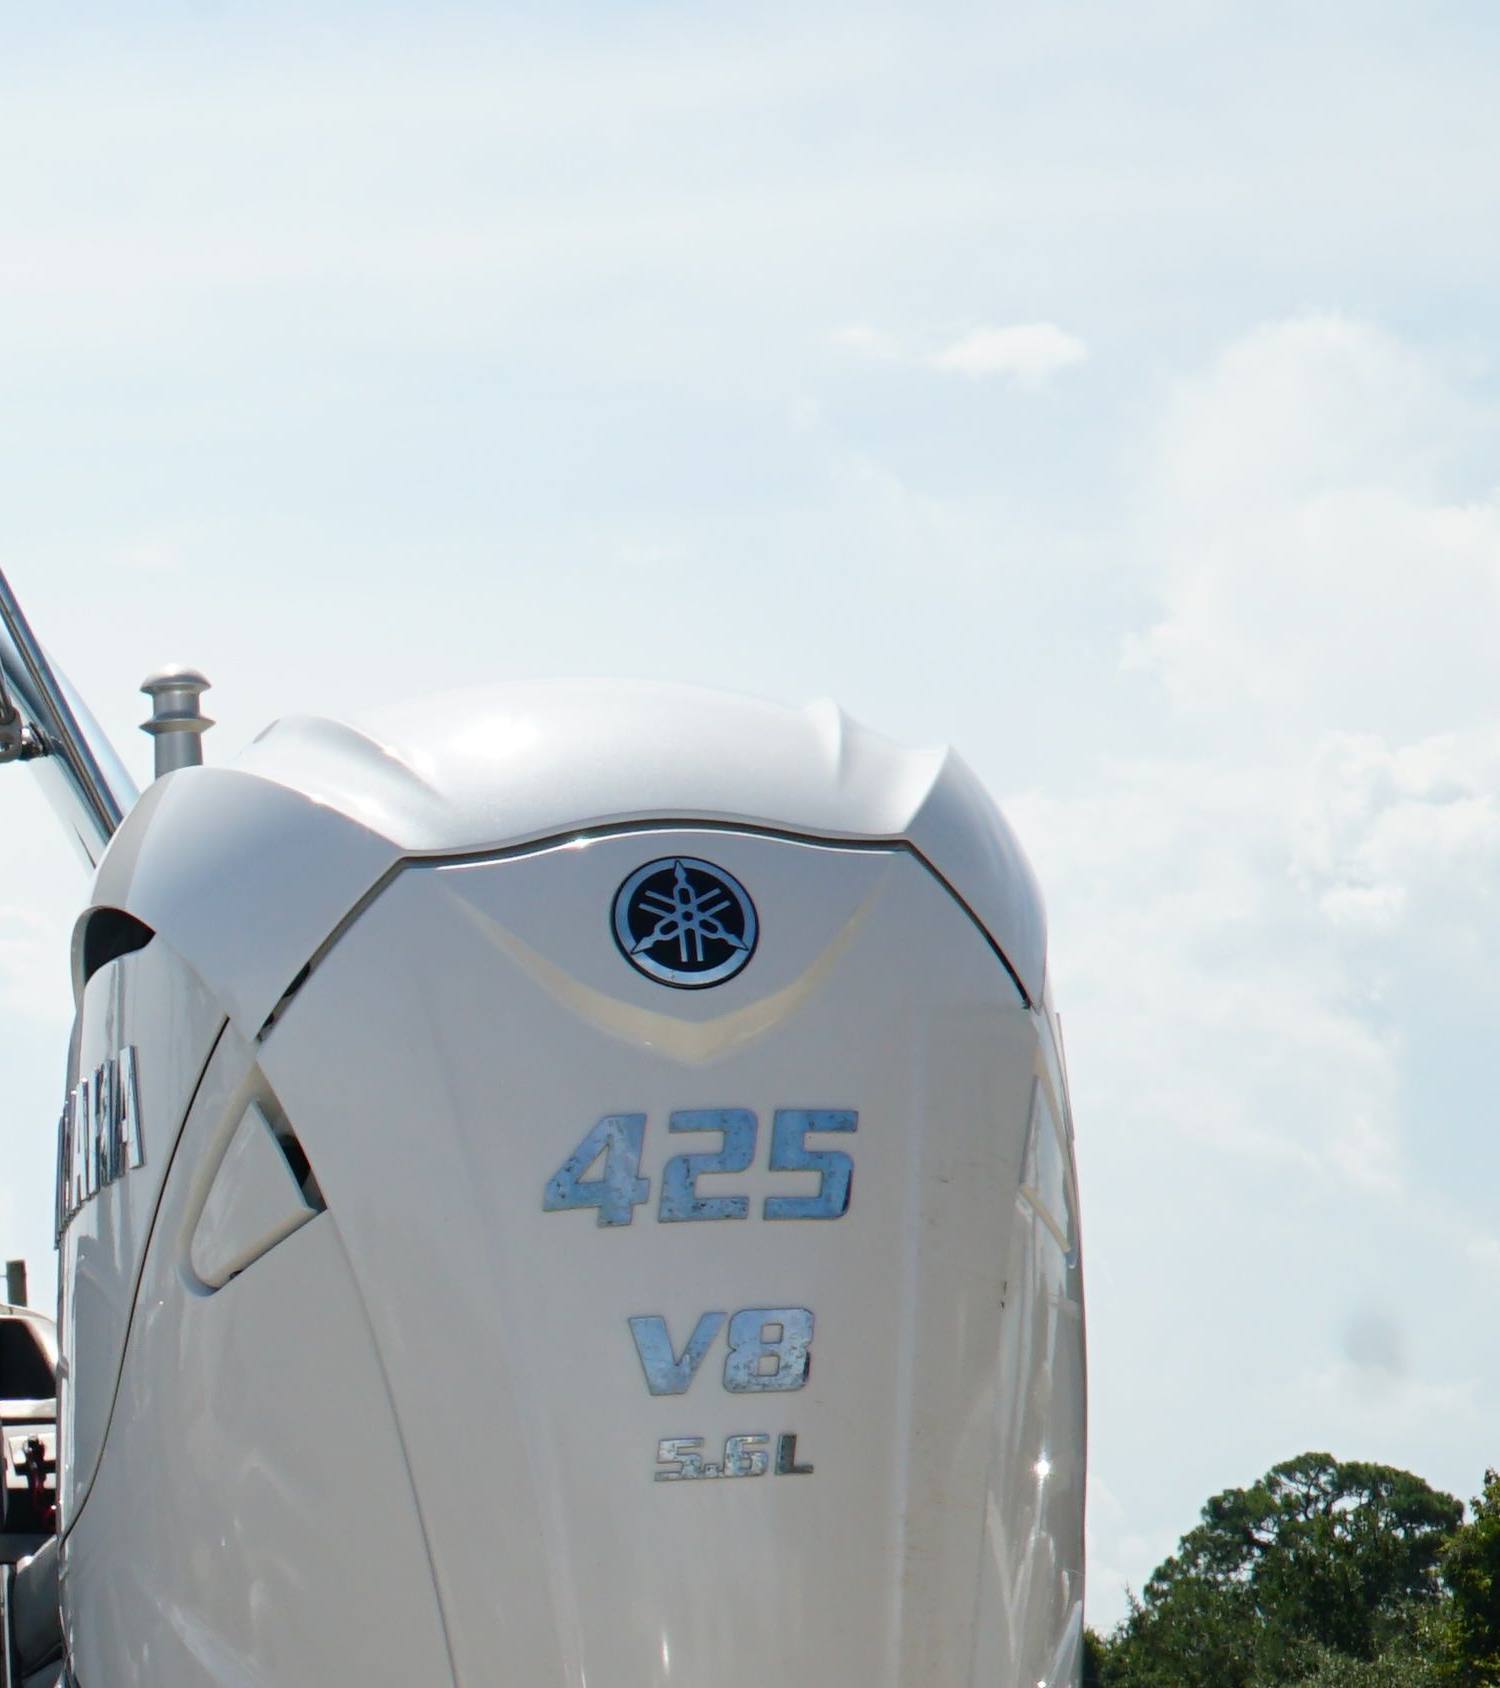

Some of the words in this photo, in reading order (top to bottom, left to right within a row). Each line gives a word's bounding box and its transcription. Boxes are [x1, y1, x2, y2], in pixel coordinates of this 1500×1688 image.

[542, 1108, 859, 1227] 425
[627, 1308, 816, 1395] V8
[653, 1433, 815, 1482] 5.6L
